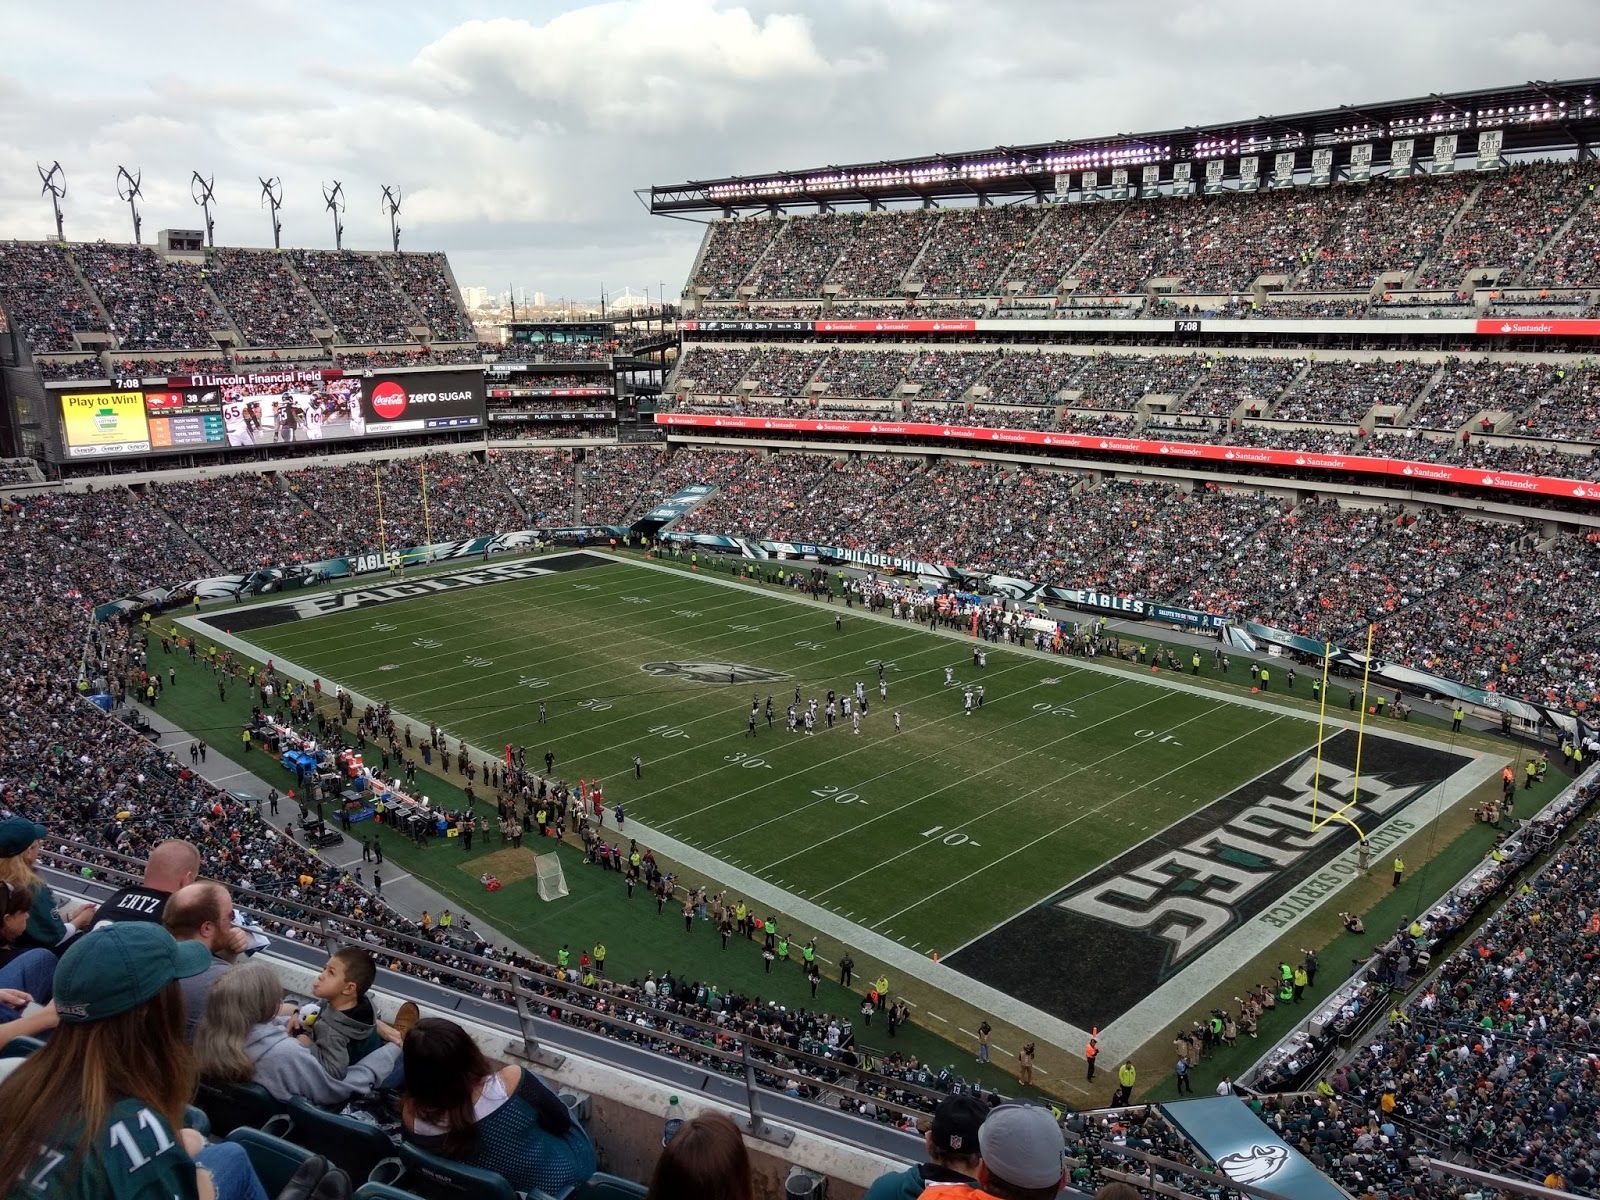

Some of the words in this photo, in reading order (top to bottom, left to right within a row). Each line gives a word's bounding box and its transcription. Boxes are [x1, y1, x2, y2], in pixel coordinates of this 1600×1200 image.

[1436, 145, 1454, 153] 2010
[1480, 140, 1500, 149] 2013
[1352, 153, 1370, 162] 2004
[1393, 150, 1411, 158] 2006
[1277, 162, 1293, 170] 2002
[1313, 158, 1330, 166] 2003
[1242, 165, 1256, 173] 2001
[832, 323, 858, 331] Santander
[883, 323, 910, 331] Santander
[1179, 322, 1198, 331] 7:08
[1512, 324, 1552, 332] Santander
[206, 375, 245, 386] Lincoln
[249, 372, 295, 384] Financial
[297, 370, 322, 382] Field
[116, 378, 139, 389] 7:08
[69, 396, 95, 409] Play
[97, 396, 109, 405] to
[111, 394, 137, 405] Win!
[171, 395, 178, 403] 9
[186, 394, 198, 403] 38
[408, 392, 437, 404] zero
[438, 390, 472, 402] SUGAR
[224, 406, 241, 421] 65
[310, 413, 320, 423] 10
[674, 417, 698, 425] Santander
[722, 419, 746, 427] Santander
[771, 421, 797, 429] Santander
[823, 423, 850, 431] Santander
[950, 429, 976, 437] Santander
[999, 433, 1026, 441] Santander
[1052, 437, 1080, 446] Santander
[1108, 442, 1140, 451] Santander
[1169, 447, 1202, 456] Santander
[1235, 452, 1271, 462] Santander
[1307, 457, 1346, 468] Santander
[1414, 467, 1452, 479] Santander
[1495, 476, 1539, 490] Santander
[837, 547, 925, 575] PHILADELPHIA
[292, 563, 560, 619] EAGLES
[1077, 590, 1144, 614] EAGLES
[576, 698, 613, 712] 50
[1032, 702, 1076, 716] 20
[647, 724, 685, 738] 40
[1133, 729, 1176, 743] 10
[723, 752, 766, 769] 30
[811, 785, 860, 804] 20
[919, 825, 970, 846] 10
[1053, 755, 1428, 960] EAGLES
[117, 893, 161, 914] ERTZ
[1258, 872, 1343, 928] SERVICE
[109, 1107, 176, 1175] 11
